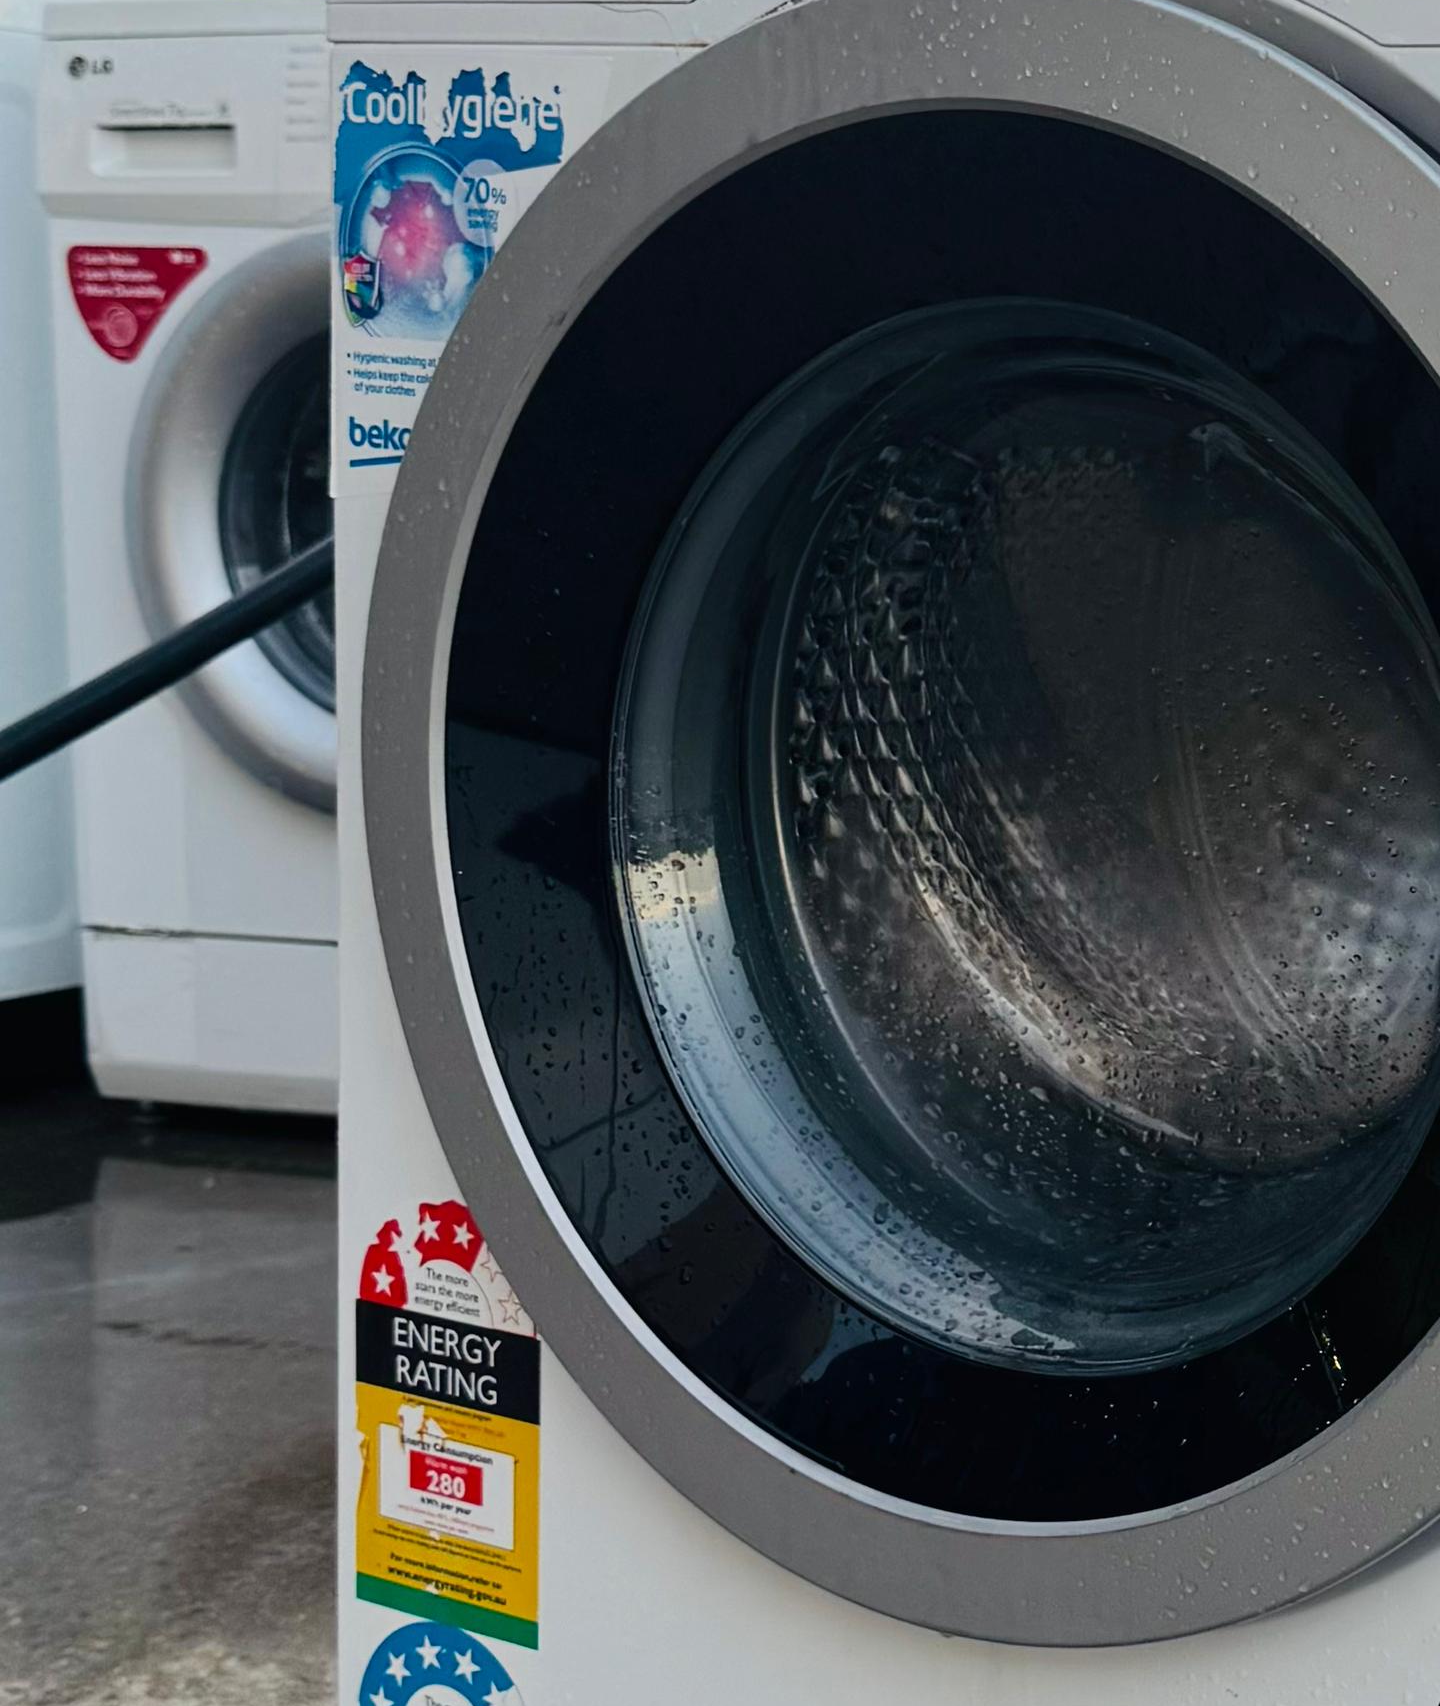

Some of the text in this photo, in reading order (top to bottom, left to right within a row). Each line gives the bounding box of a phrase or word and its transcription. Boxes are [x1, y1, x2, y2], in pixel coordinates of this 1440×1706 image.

[426, 1267, 469, 1287] The more
[414, 1295, 445, 1311] energy
[415, 1282, 479, 1304] stars the more
[393, 1316, 502, 1368] ENERGY
[396, 1354, 498, 1406] RATING
[425, 1469, 467, 1499] 280
